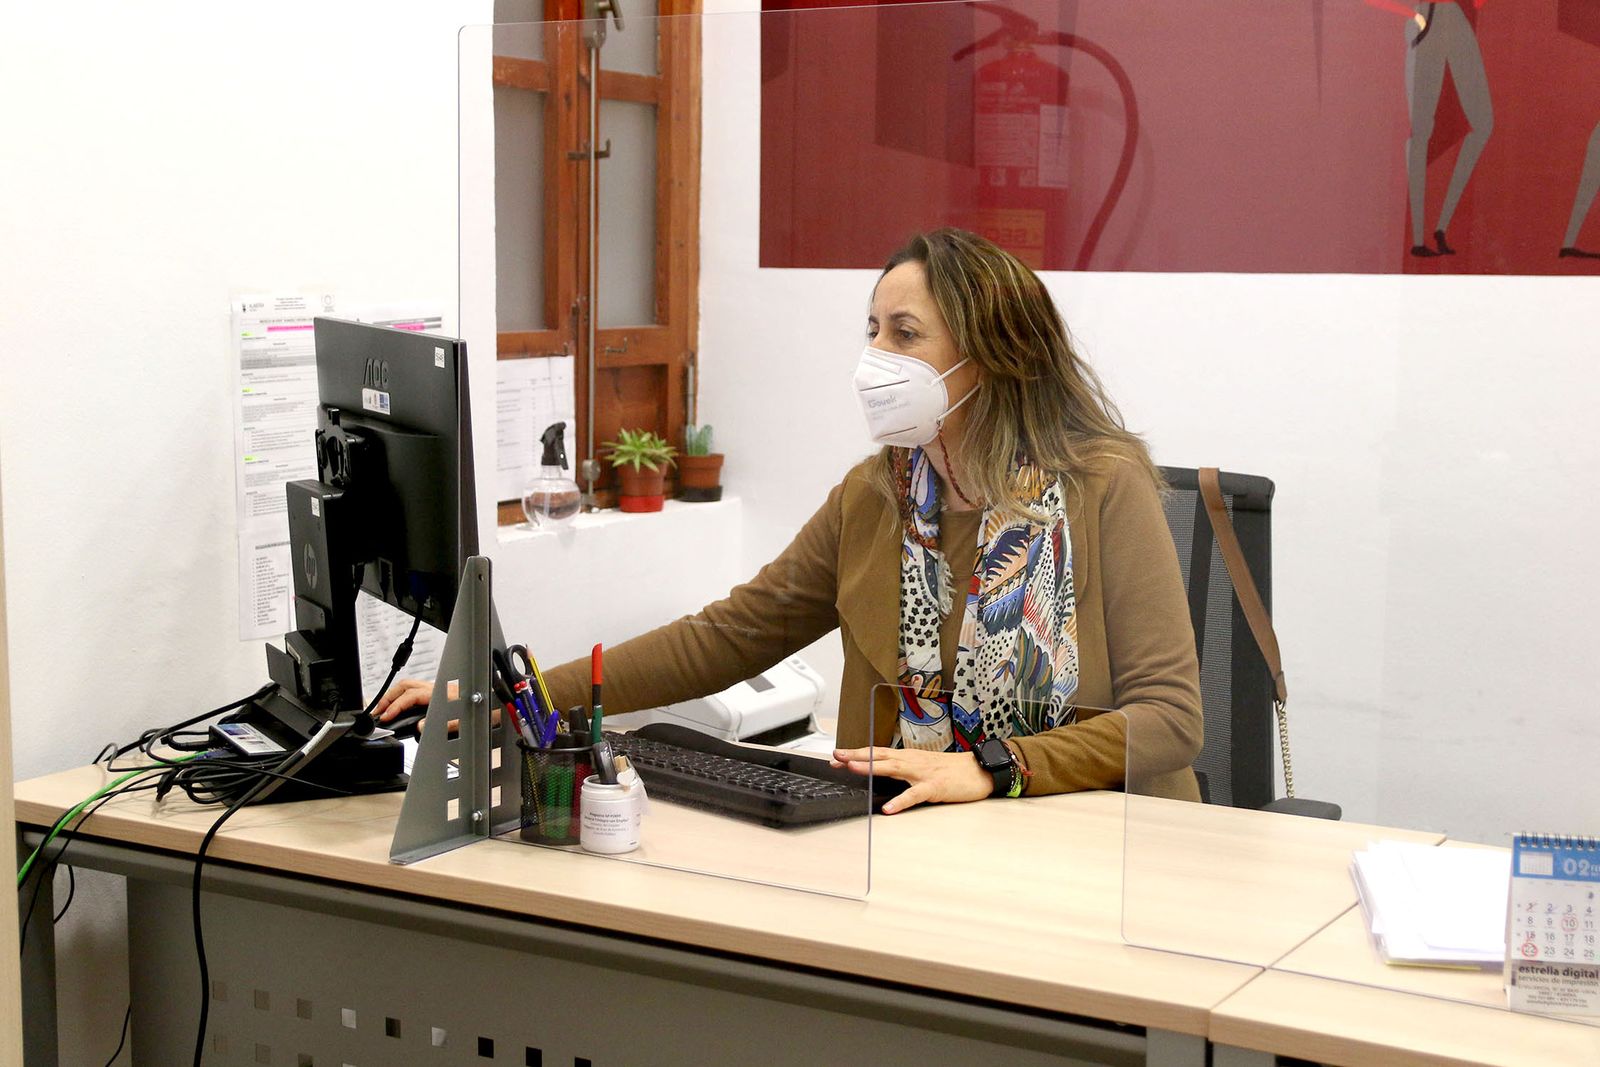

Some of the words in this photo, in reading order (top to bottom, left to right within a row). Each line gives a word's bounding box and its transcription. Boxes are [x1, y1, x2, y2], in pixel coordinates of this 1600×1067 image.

[363, 357, 389, 389] AOC
[1563, 857, 1590, 876] 02
[1546, 903, 1553, 912] 2
[1566, 904, 1573, 913] 3
[1527, 916, 1533, 924] 8
[1546, 917, 1553, 926] 9
[1565, 918, 1576, 927] 10
[1585, 920, 1594, 928] 11
[1545, 932, 1555, 941] 16
[1565, 933, 1575, 942] 17
[1584, 935, 1595, 944] 18
[1524, 945, 1535, 954] 22
[1544, 946, 1555, 955] 23
[1563, 948, 1574, 956] 24
[1583, 949, 1595, 957] 25
[1518, 965, 1560, 976] estrella
[1562, 967, 1599, 979] digital
[1518, 975, 1550, 983] servicios
